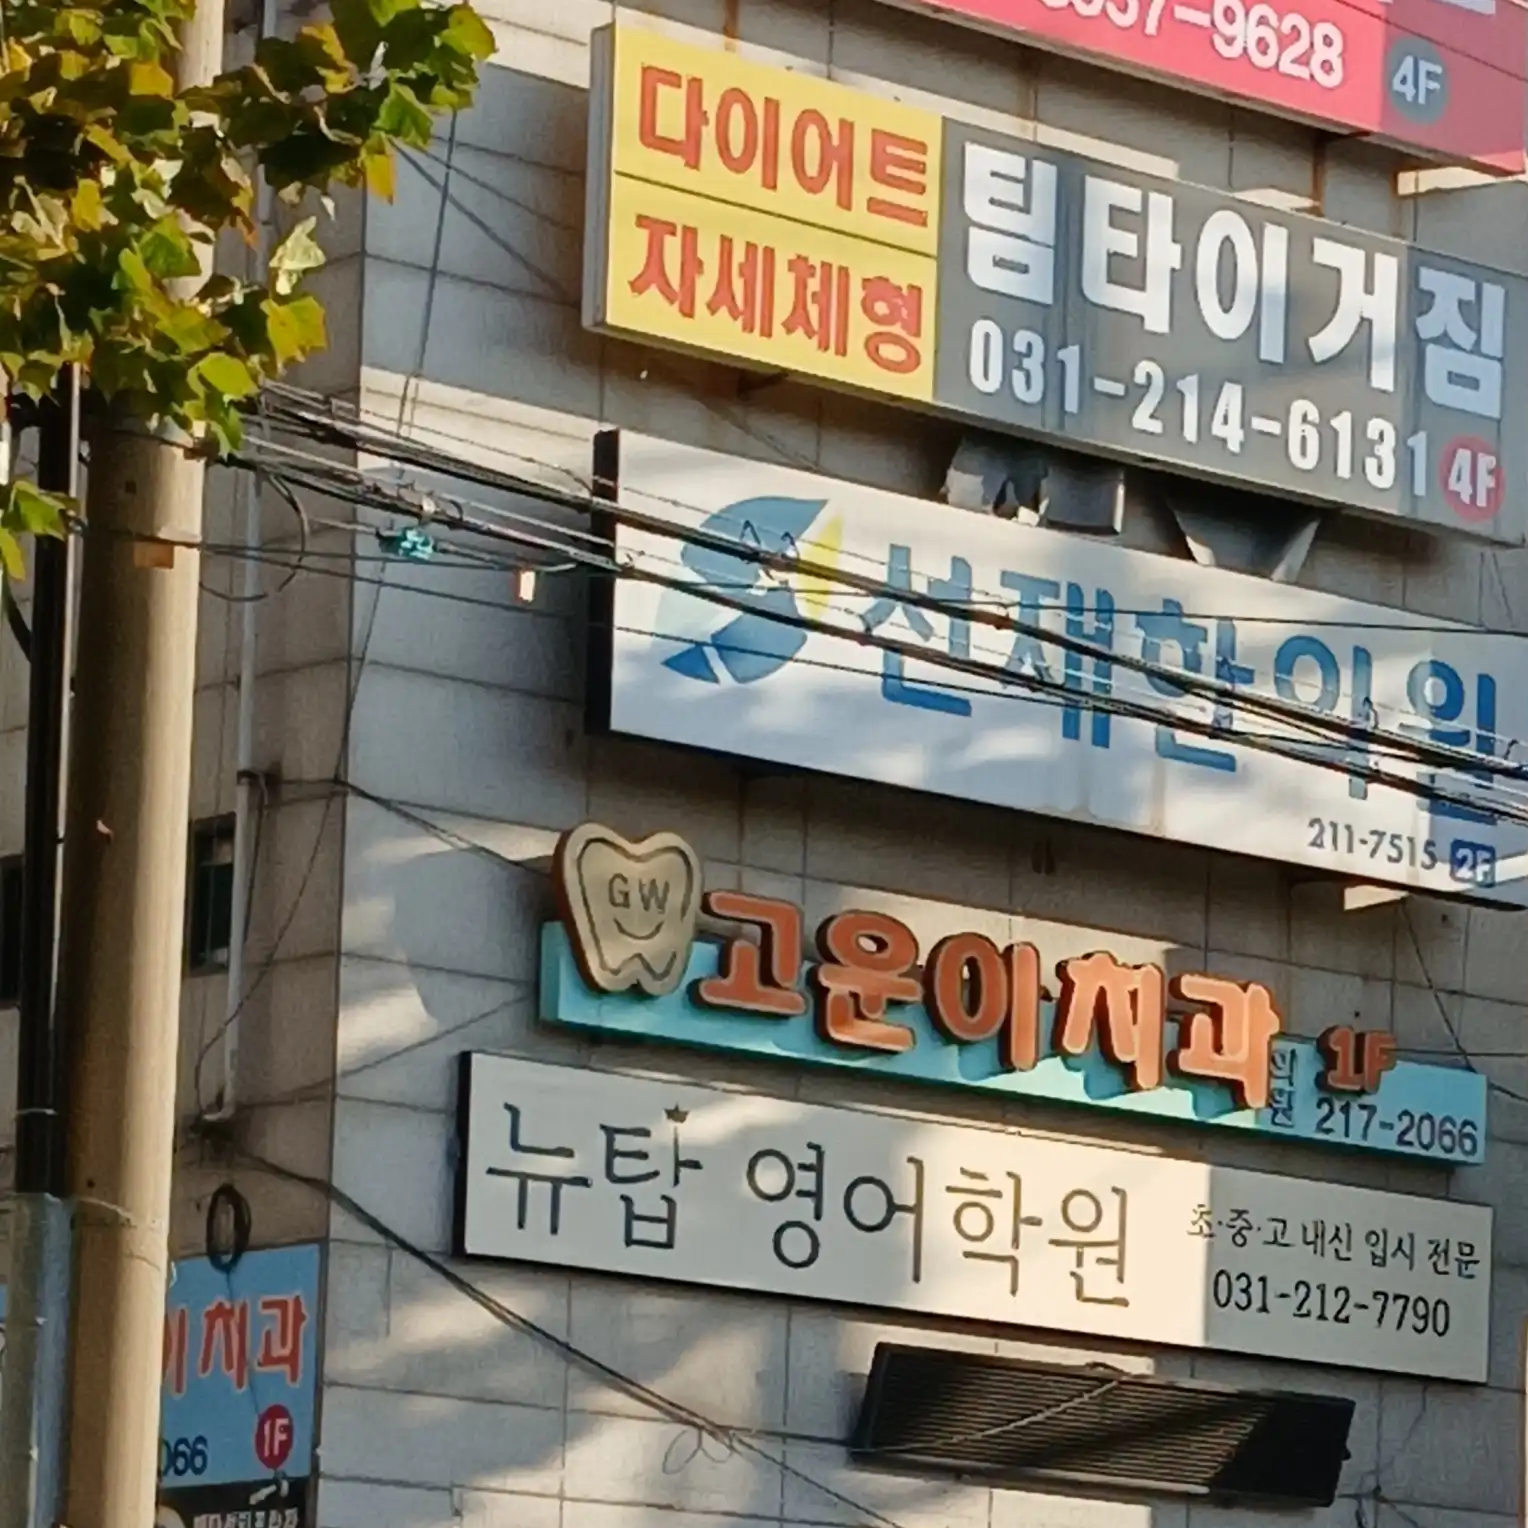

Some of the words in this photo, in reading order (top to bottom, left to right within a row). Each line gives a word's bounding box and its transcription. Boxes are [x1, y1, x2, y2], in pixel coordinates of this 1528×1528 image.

[1393, 55, 1442, 105] 4F
[638, 62, 929, 228] 다이어트
[630, 213, 924, 374] 자세체형
[963, 141, 1509, 419] 팀타이거짐
[968, 318, 1429, 500] 031-214-6131
[1447, 447, 1497, 507] 4F
[1308, 816, 1439, 871] 211-7515
[1454, 847, 1495, 882] 2F
[607, 873, 669, 914] GW
[699, 889, 1280, 1110] 고운이치과
[1317, 1025, 1398, 1095] 1F
[1314, 1096, 1478, 1157] 217-2066
[487, 1101, 702, 1251] 뉴탑
[746, 1140, 1131, 1310] 영어학원
[1302, 1219, 1353, 1262] 내신
[1364, 1228, 1416, 1272] 입시
[1427, 1238, 1481, 1280] 전문
[1212, 1268, 1451, 1338] 031-212-7790
[262, 1417, 290, 1458] 1F
